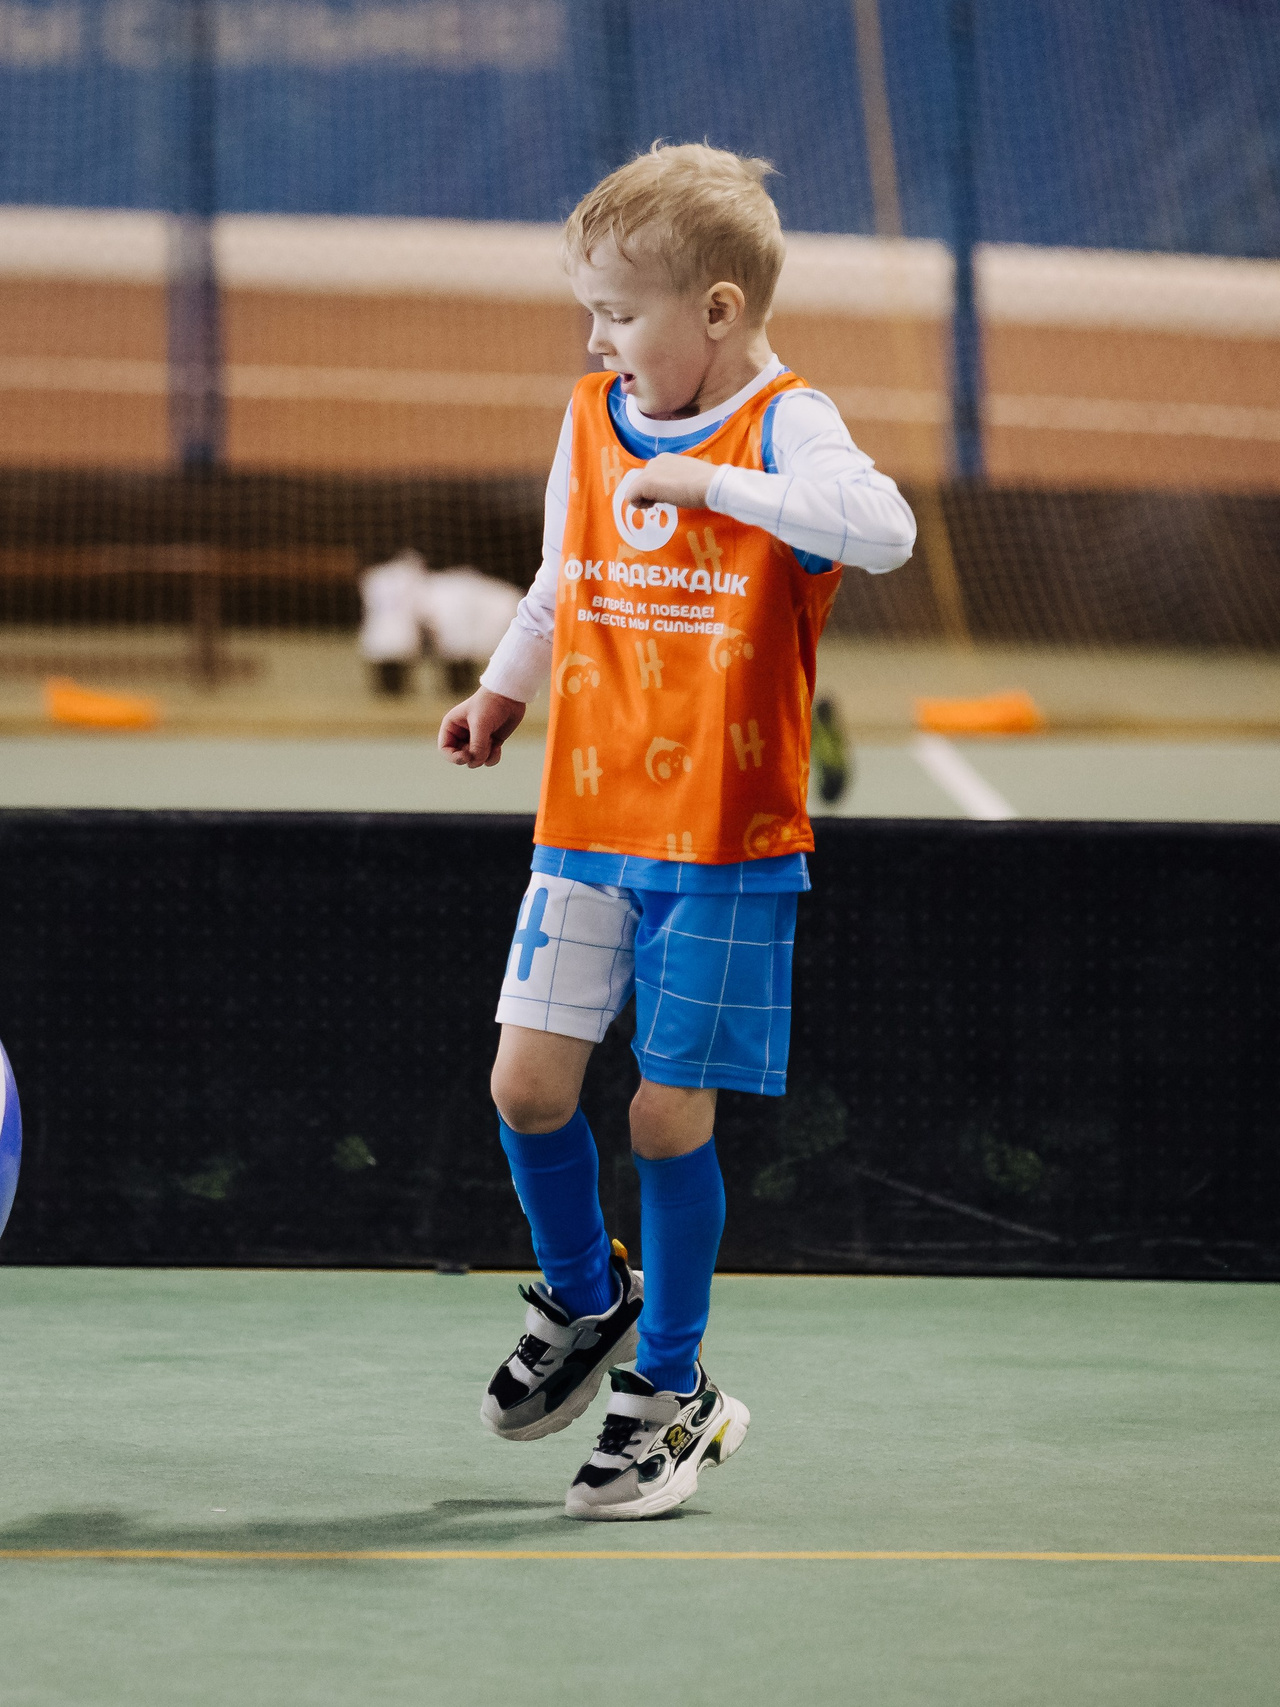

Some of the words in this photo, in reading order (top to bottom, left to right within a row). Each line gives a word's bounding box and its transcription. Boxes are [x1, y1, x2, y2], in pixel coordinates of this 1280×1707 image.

[563, 558, 604, 581] ФК
[607, 560, 751, 598] НАДЕЖДИК
[577, 608, 627, 629] ВМЕСТЕ
[628, 617, 650, 631] МЫ
[652, 619, 726, 636] СИЛЬНЕЕ!
[636, 602, 648, 615] К
[650, 603, 716, 620] ПОБЕДЕ!
